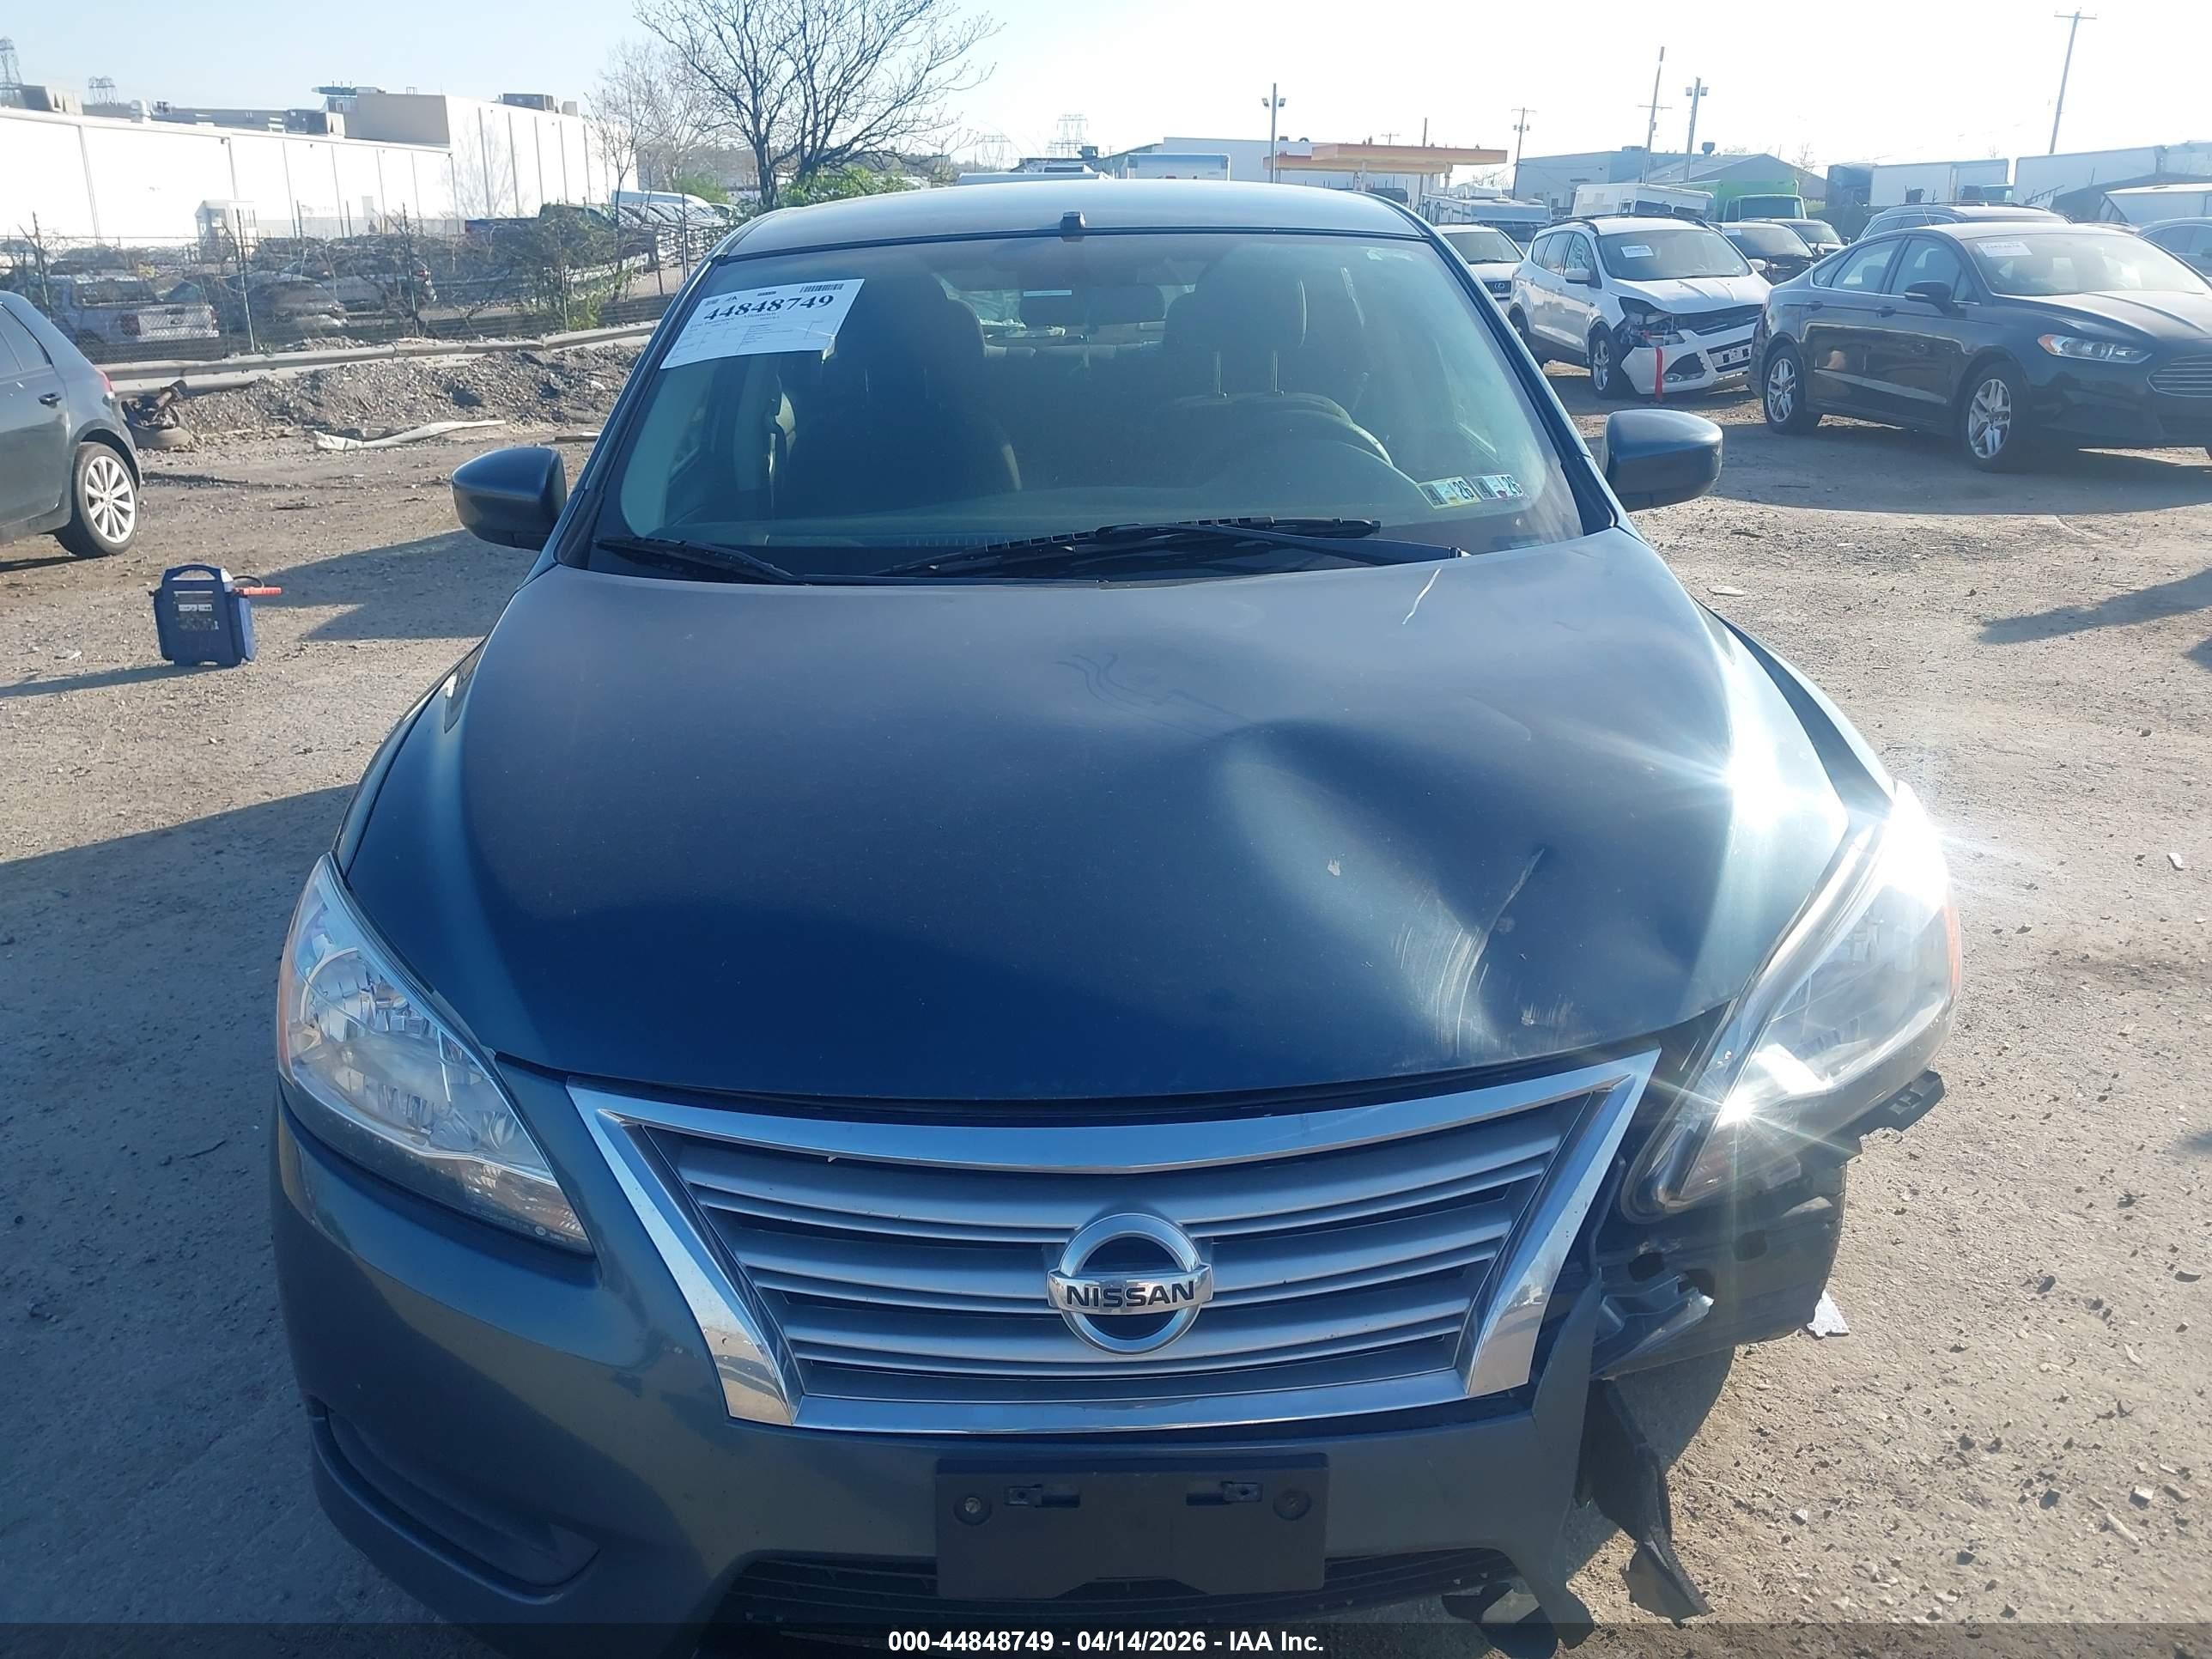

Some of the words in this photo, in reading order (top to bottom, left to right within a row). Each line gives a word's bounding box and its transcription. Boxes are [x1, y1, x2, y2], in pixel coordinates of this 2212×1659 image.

[704, 295, 834, 319] 44848749
[1452, 480, 1474, 499] 26
[1500, 476, 1523, 495] 26
[1066, 1280, 1194, 1308] NISSAN
